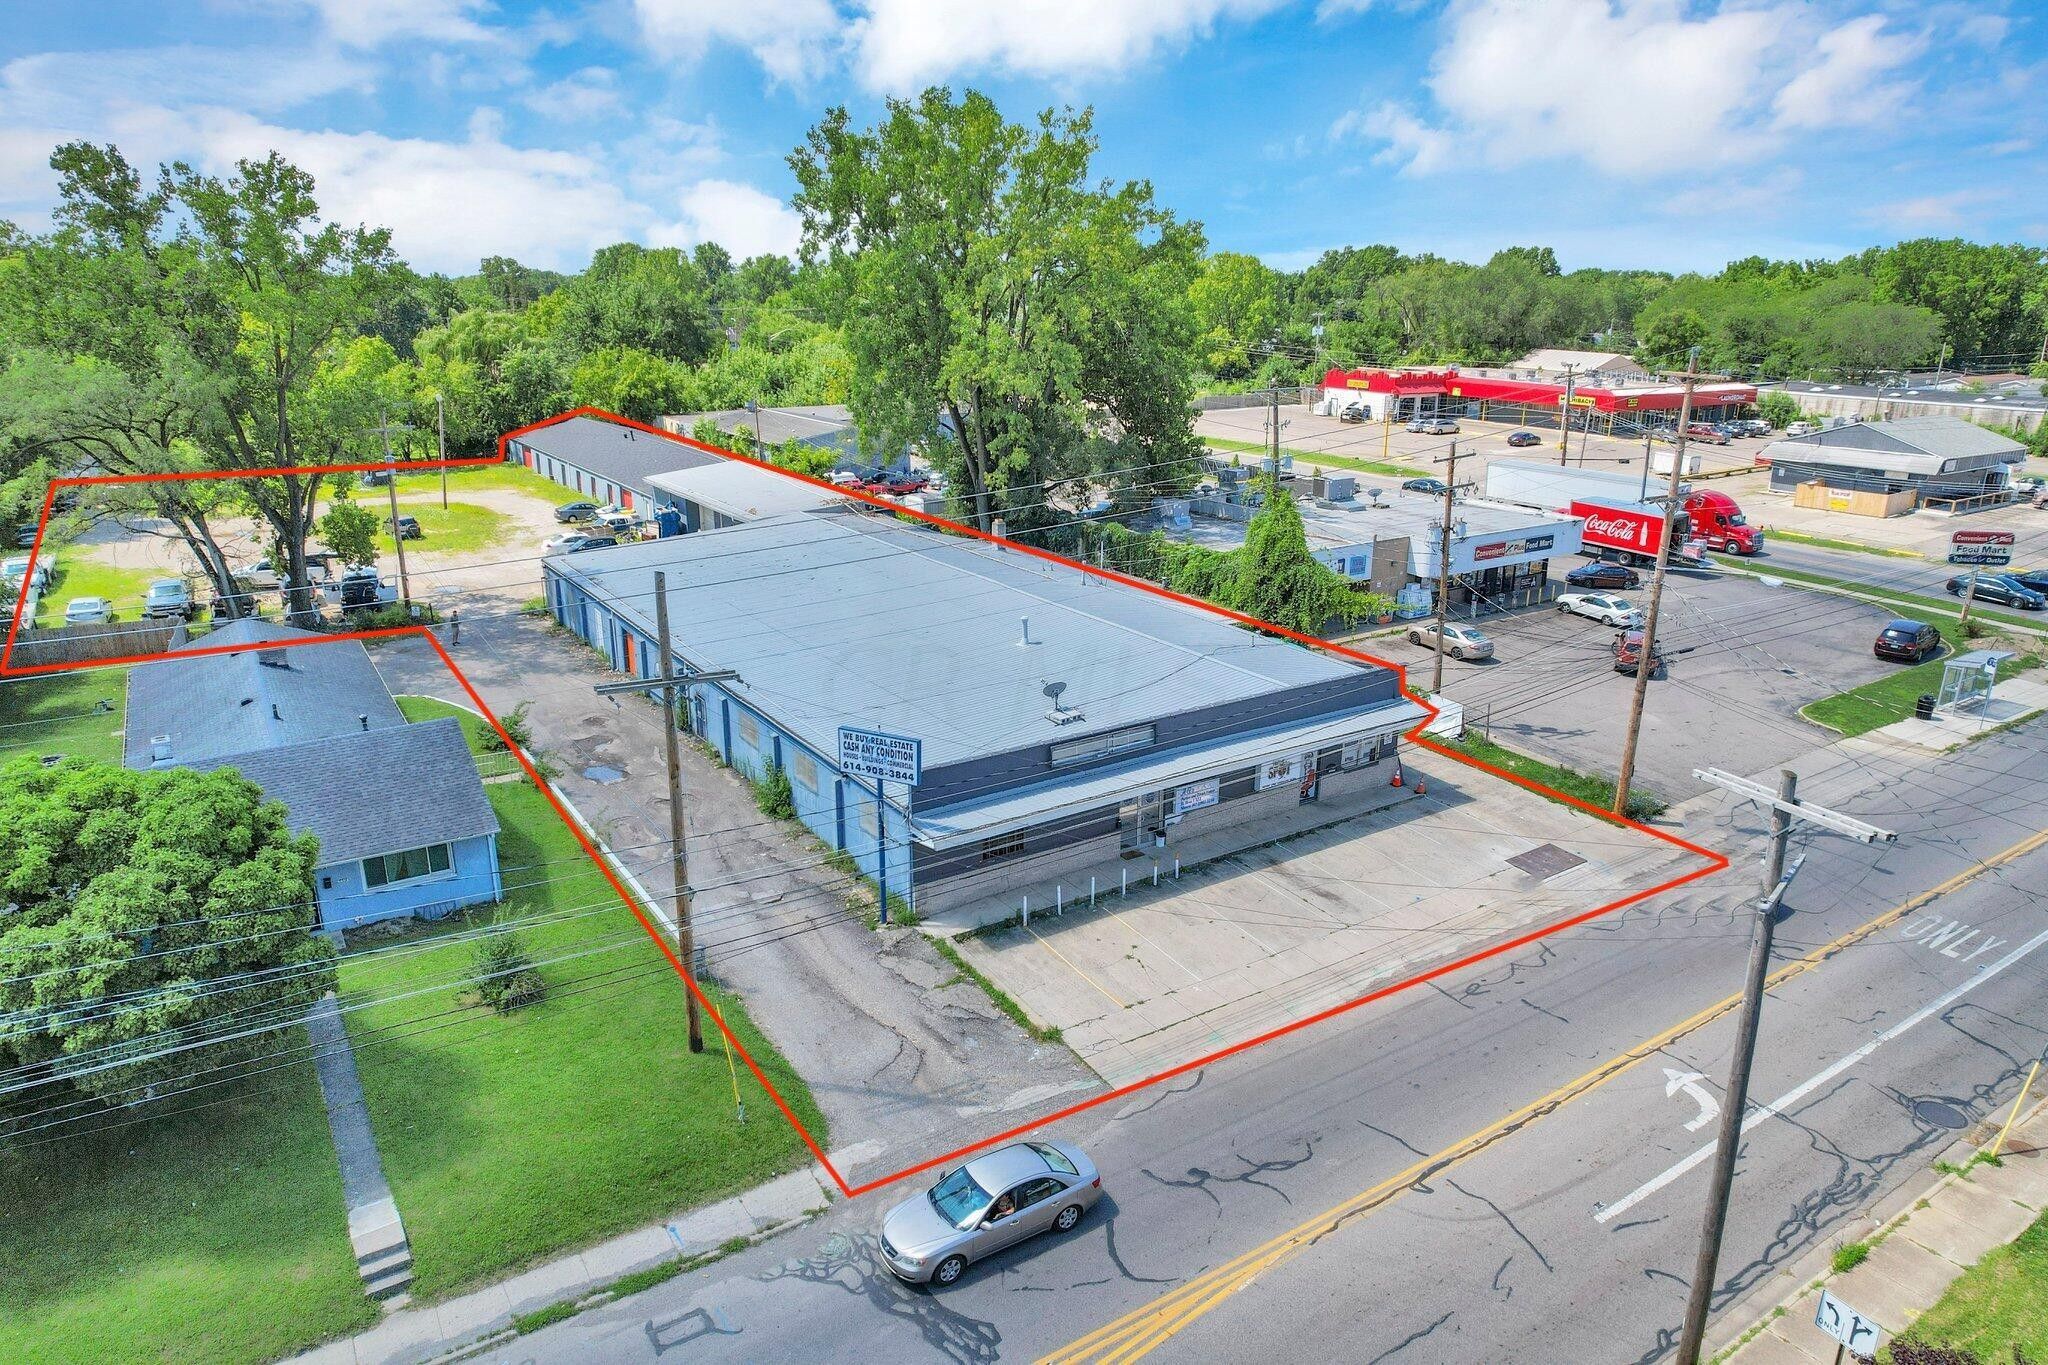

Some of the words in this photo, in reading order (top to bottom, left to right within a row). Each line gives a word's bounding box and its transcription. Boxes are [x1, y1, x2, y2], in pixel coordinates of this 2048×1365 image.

[1526, 541, 1538, 549] Food
[1956, 545, 1980, 553] Food
[1981, 546, 2007, 554] Mart
[843, 732, 853, 740] WE
[855, 735, 868, 743] BUY
[871, 736, 888, 746] REAL
[890, 740, 913, 751] ESTATE
[843, 741, 859, 752] CASH
[861, 744, 874, 755] ANY
[876, 747, 913, 762] CONDITION
[887, 760, 914, 770] COMMERCIAL
[1901, 915, 2008, 963] ONLY
[1818, 1317, 1840, 1335] ONLY
